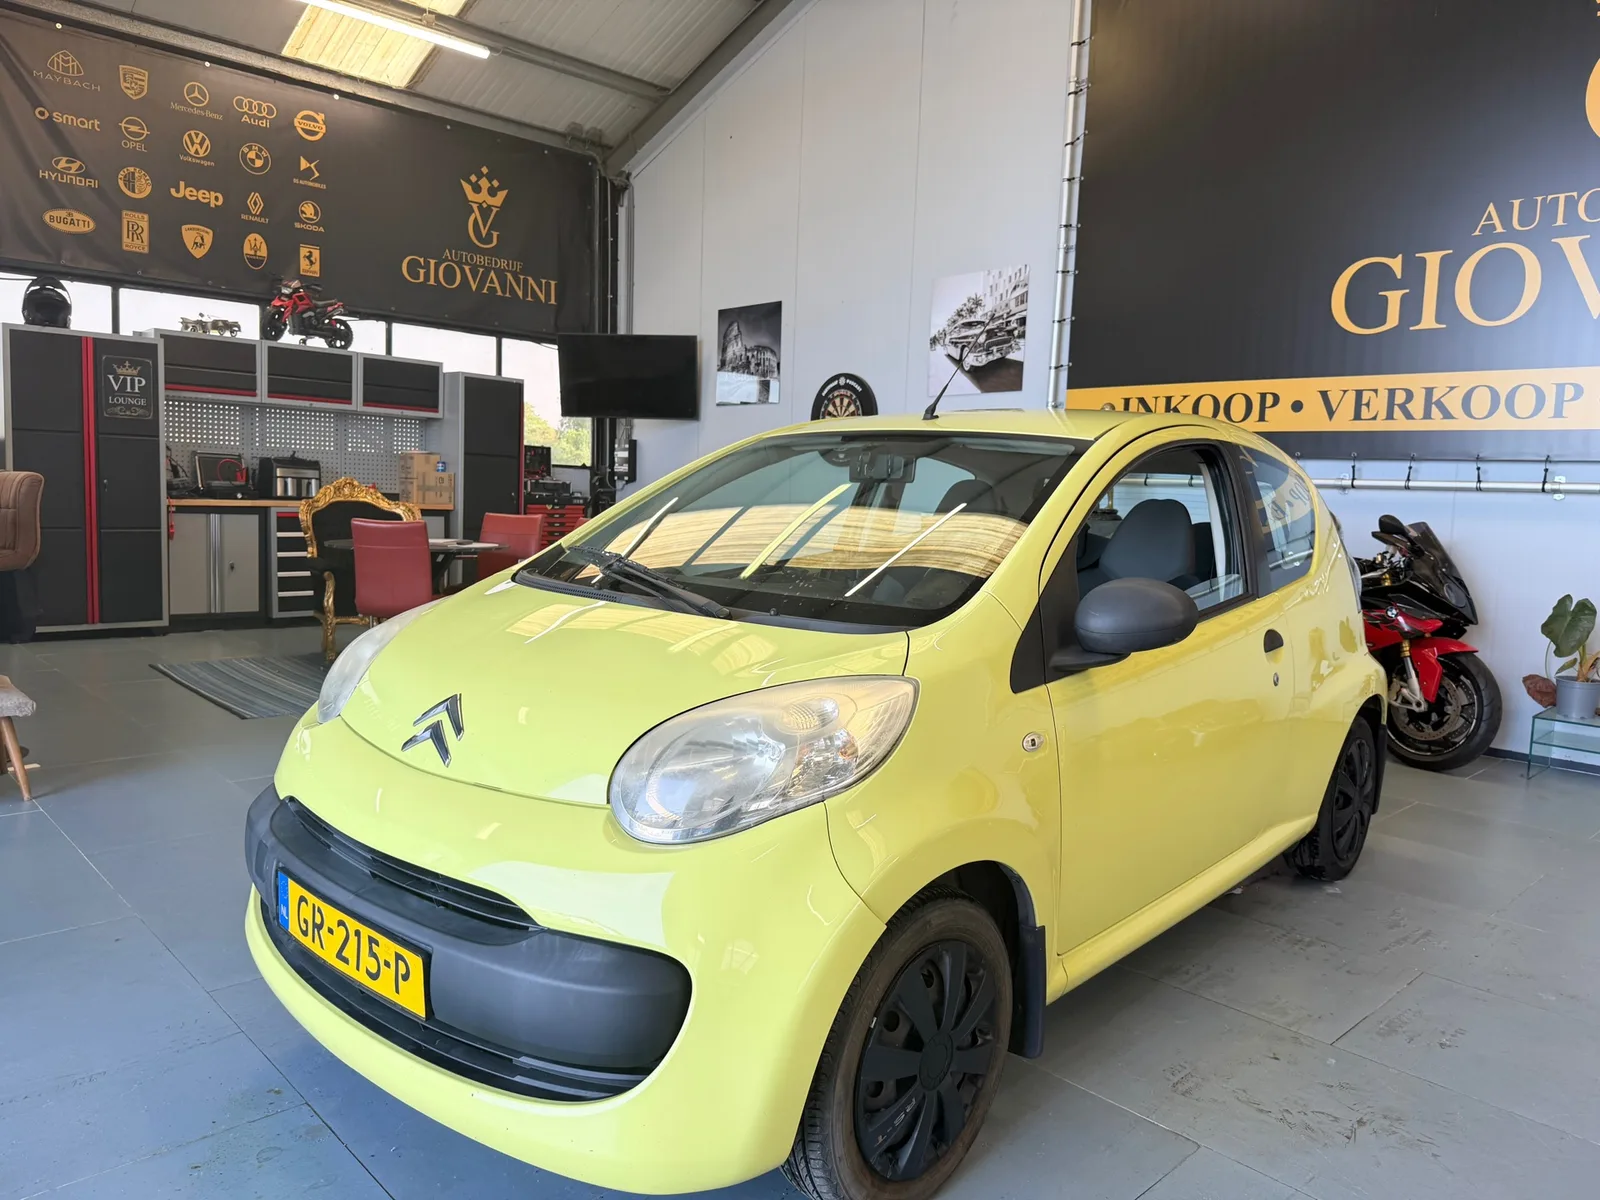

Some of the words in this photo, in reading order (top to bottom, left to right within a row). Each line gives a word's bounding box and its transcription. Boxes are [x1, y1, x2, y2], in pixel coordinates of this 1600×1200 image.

[33, 70, 100, 91] MAYBACH
[170, 102, 223, 121] Mercedes-Benz
[53, 112, 100, 131] smart
[241, 114, 270, 128] Audi
[297, 120, 324, 131] VOLVO
[121, 140, 147, 153] OPEL
[179, 154, 215, 167] Volkswagen
[39, 170, 99, 188] HYUNDAI
[170, 181, 223, 208] Jeep
[49, 215, 91, 228] BUGATTI
[124, 212, 145, 220] ROLLS
[241, 213, 269, 224] RENAULT
[125, 243, 146, 251] ROYCE
[442, 249, 524, 272] AUTOBEDRIJF
[401, 255, 558, 305] GIOVANNI
[107, 374, 146, 393] VIP
[109, 396, 147, 406] LOUNGE
[1121, 391, 1281, 423] INKOOP
[1317, 382, 1585, 421] VERKOOP
[281, 903, 289, 920] NL
[297, 895, 411, 995] GR-215-P
